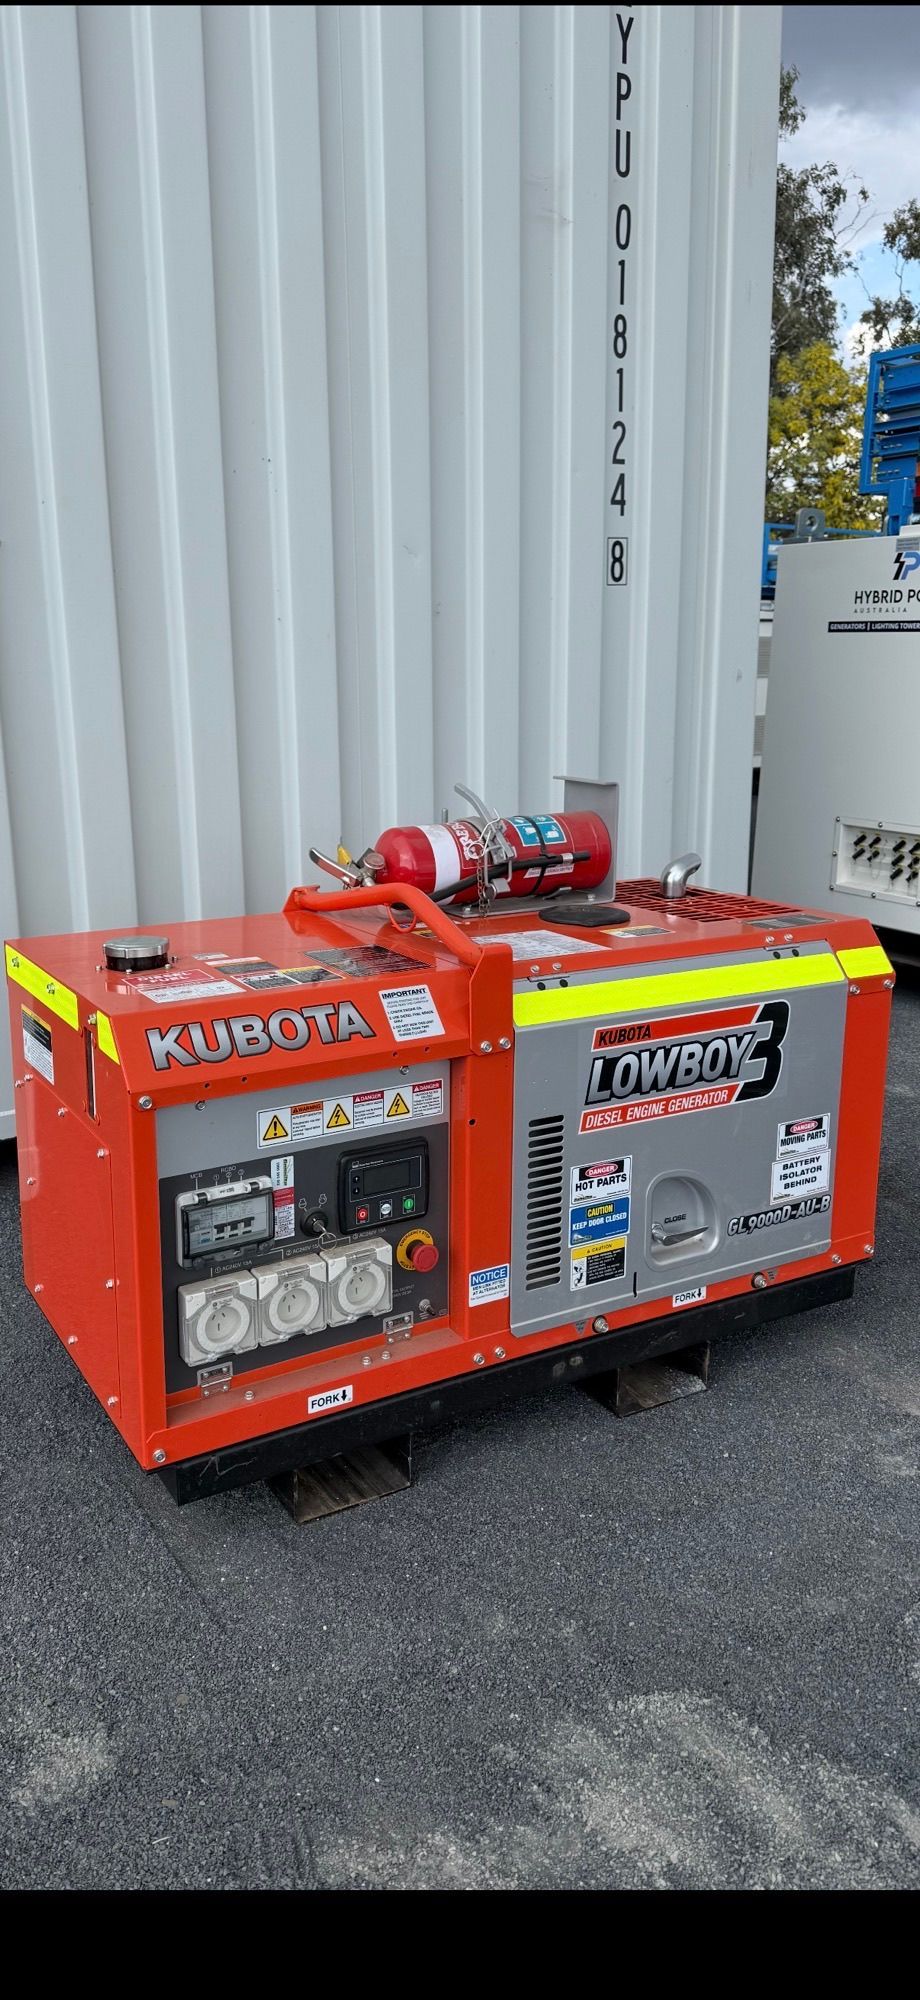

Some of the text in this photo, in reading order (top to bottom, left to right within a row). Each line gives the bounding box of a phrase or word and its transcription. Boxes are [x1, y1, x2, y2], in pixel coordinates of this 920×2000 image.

[610, 5, 634, 583] YPU 018124 8
[854, 589, 904, 605] HYBRID
[853, 606, 908, 614] AUSTRALIA
[830, 622, 866, 630] GENERATORS
[871, 621, 899, 630] LIGHTING
[381, 987, 427, 1000] IMPORTANT
[145, 1000, 377, 1072] KUBOTA
[598, 1025, 651, 1046] KUBOTA
[585, 1031, 757, 1105] LOWBOY
[585, 1089, 729, 1129] DIESEL ENGINE GENERATOR
[793, 1122, 815, 1132] DANGER
[780, 1134, 806, 1147] MOVING
[806, 1129, 827, 1142] PARTS
[588, 1165, 615, 1176] DANGER
[782, 1155, 821, 1171] BATTERY
[780, 1165, 822, 1181] ISOLATOR
[575, 1173, 627, 1192] HOT PARTS
[783, 1176, 817, 1190] BEHIND
[587, 1203, 614, 1217] CAUTION
[727, 1195, 832, 1237] GL9000D-AU-B
[572, 1212, 627, 1231] KEEP DOOR CLOSED
[664, 1213, 687, 1224] CLOSE
[592, 1243, 613, 1253] CAUTION
[472, 1268, 506, 1285] NOTICE
[675, 1290, 697, 1304] FORK
[311, 1393, 340, 1410] FORK
